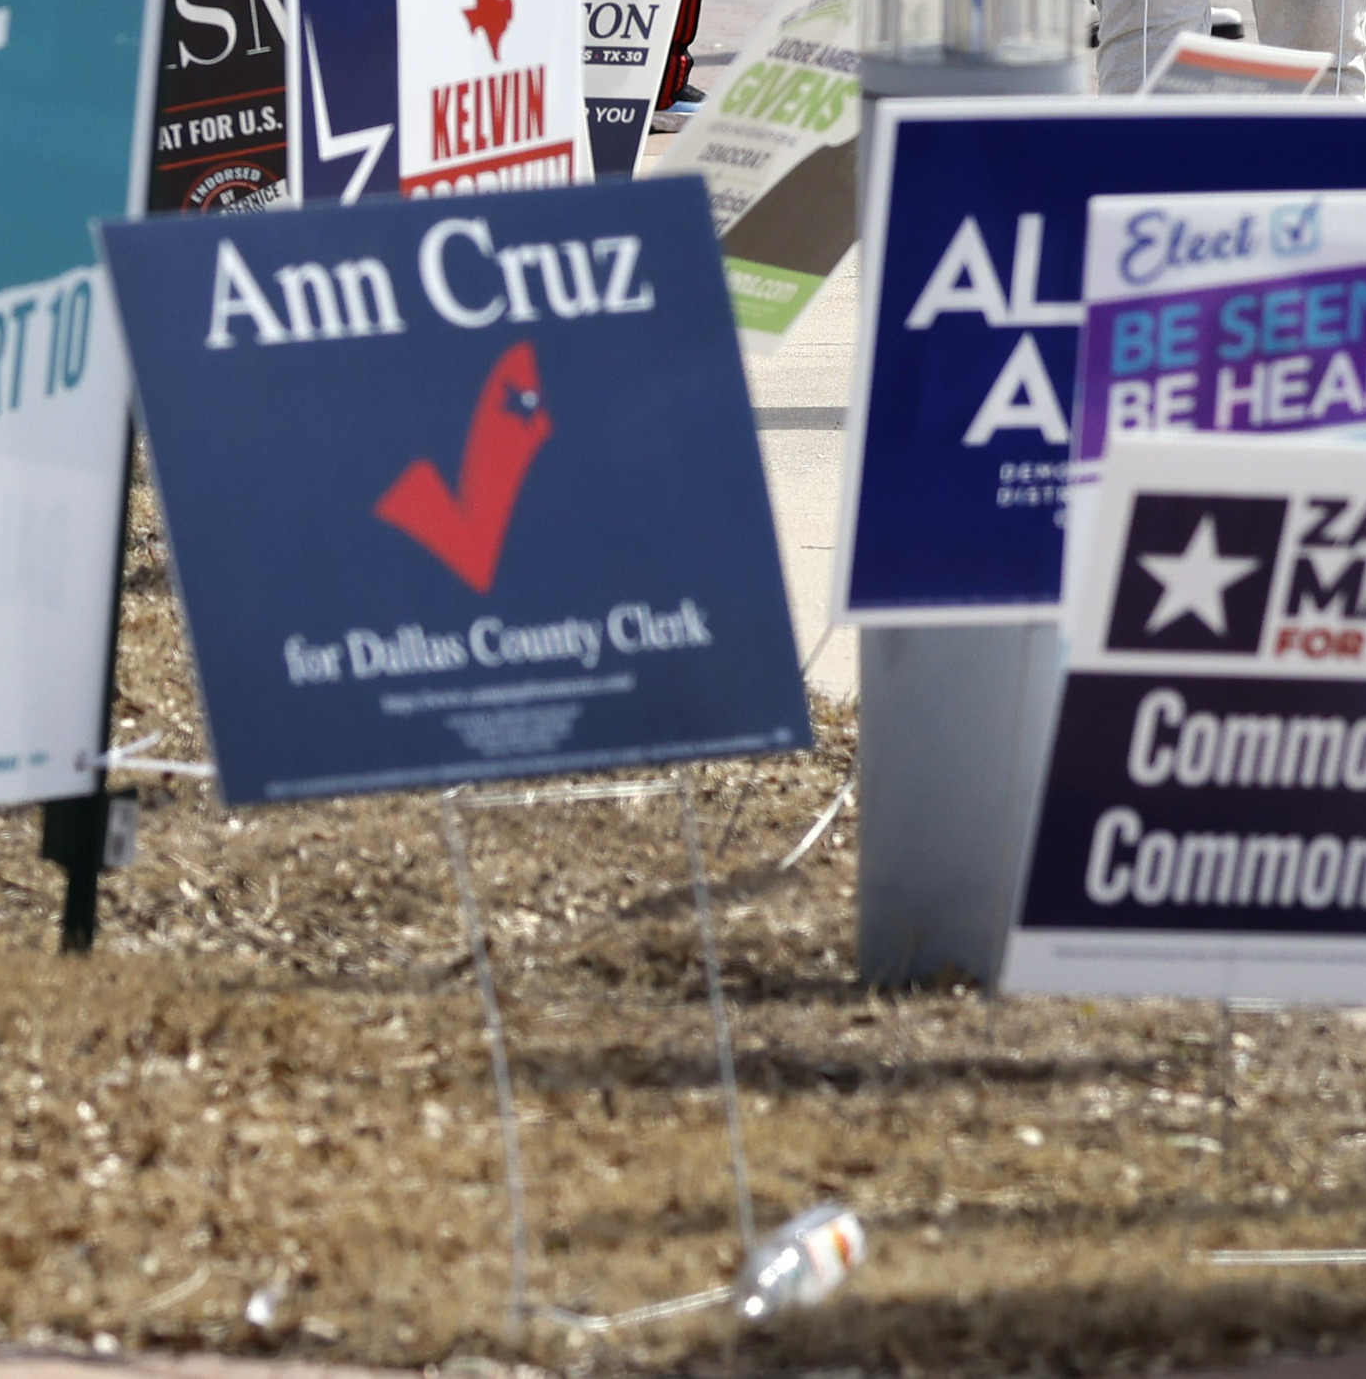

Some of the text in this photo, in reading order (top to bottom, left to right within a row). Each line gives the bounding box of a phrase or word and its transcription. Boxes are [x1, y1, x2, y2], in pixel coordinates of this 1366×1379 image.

[603, 51, 642, 62] TX-30
[188, 113, 235, 147] FOR
[239, 105, 285, 136] U.S.
[431, 63, 546, 162] KELVIN
[595, 107, 635, 123] YOU
[190, 167, 262, 204] ENDORSED
[219, 188, 236, 206] BY
[1119, 206, 1261, 287] Elect
[205, 217, 655, 350] Ann Cruz
[46, 277, 93, 396] 10
[1111, 300, 1201, 376] BE
[963, 332, 1072, 447] A
[1108, 370, 1195, 439] BE
[284, 597, 713, 685] for Dallas County Clerk
[1271, 626, 1366, 663] FOR
